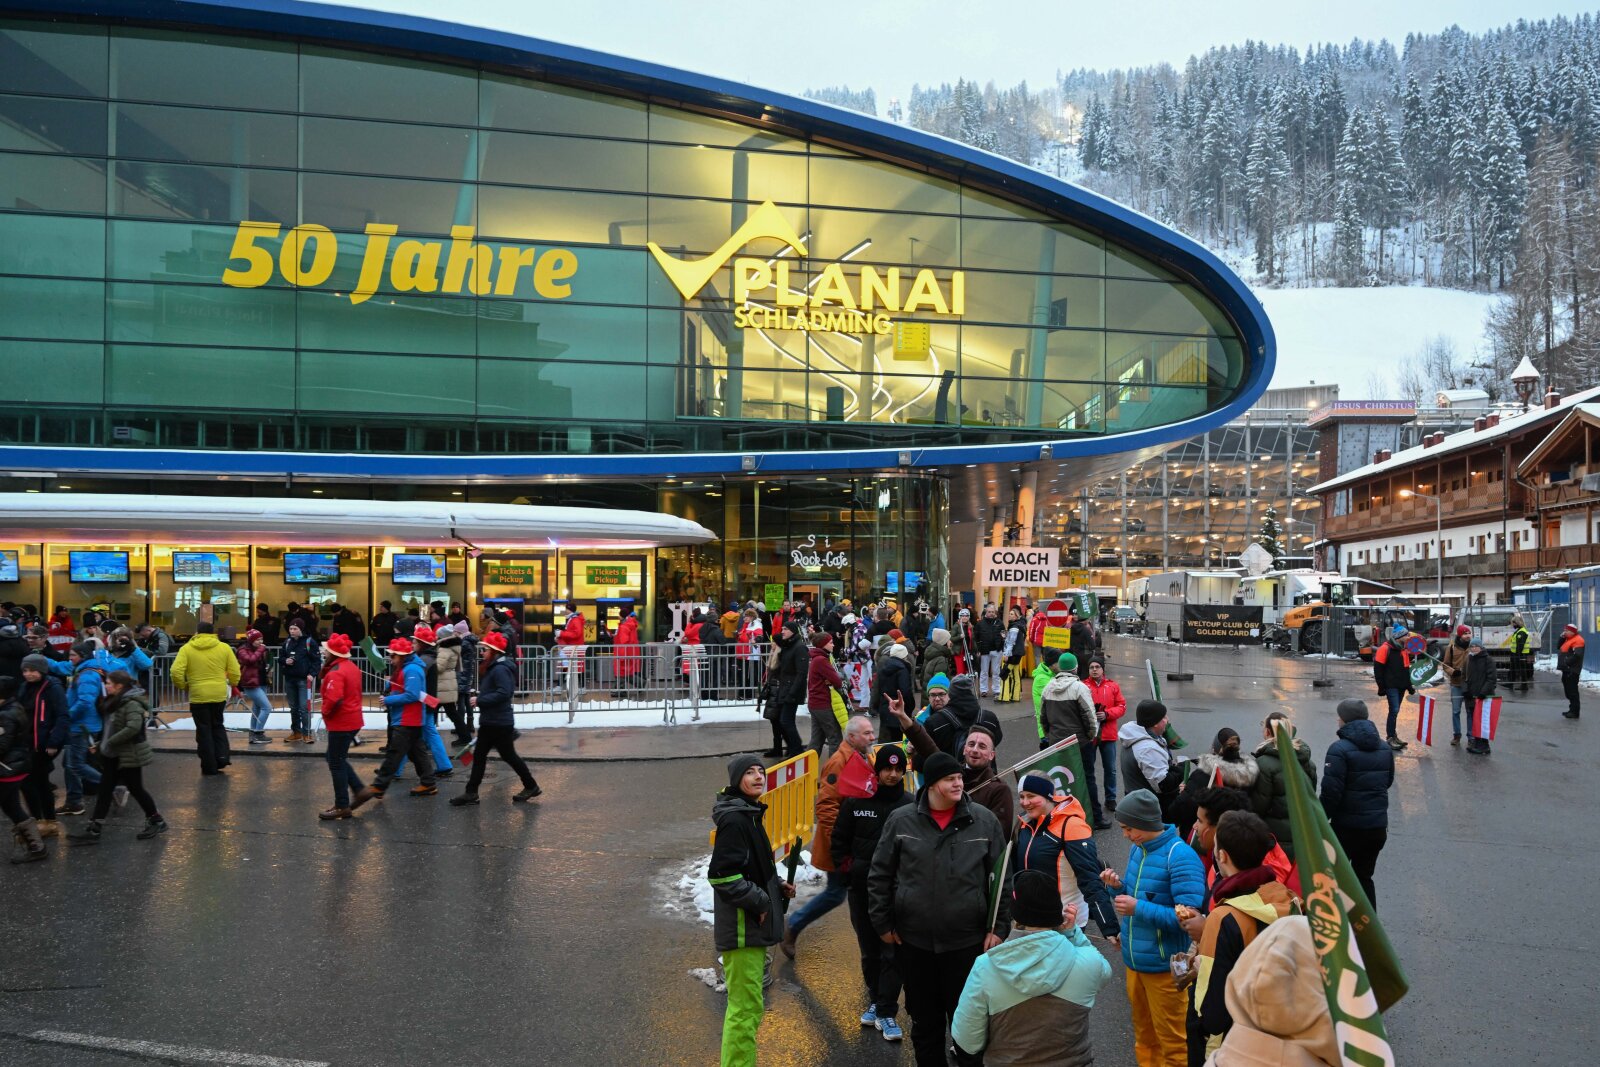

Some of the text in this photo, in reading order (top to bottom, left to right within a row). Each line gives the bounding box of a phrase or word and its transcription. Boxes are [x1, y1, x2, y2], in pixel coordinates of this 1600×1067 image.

[221, 221, 578, 305] 50 Jahre
[734, 257, 965, 315] PLANAI
[734, 306, 892, 335] SCHLADMING
[1334, 402, 1413, 410] JESUS CHRISTUS
[992, 552, 1049, 565] COACH
[595, 568, 620, 576] Tickets
[989, 568, 1051, 582] MEDIEN
[499, 575, 524, 584] Pickup
[594, 576, 619, 584] Pickup
[1187, 620, 1221, 628] WELTCUP
[1222, 621, 1243, 629] CLUB
[1196, 628, 1250, 637] GOLDEN CARD
[853, 810, 878, 818] KARL
